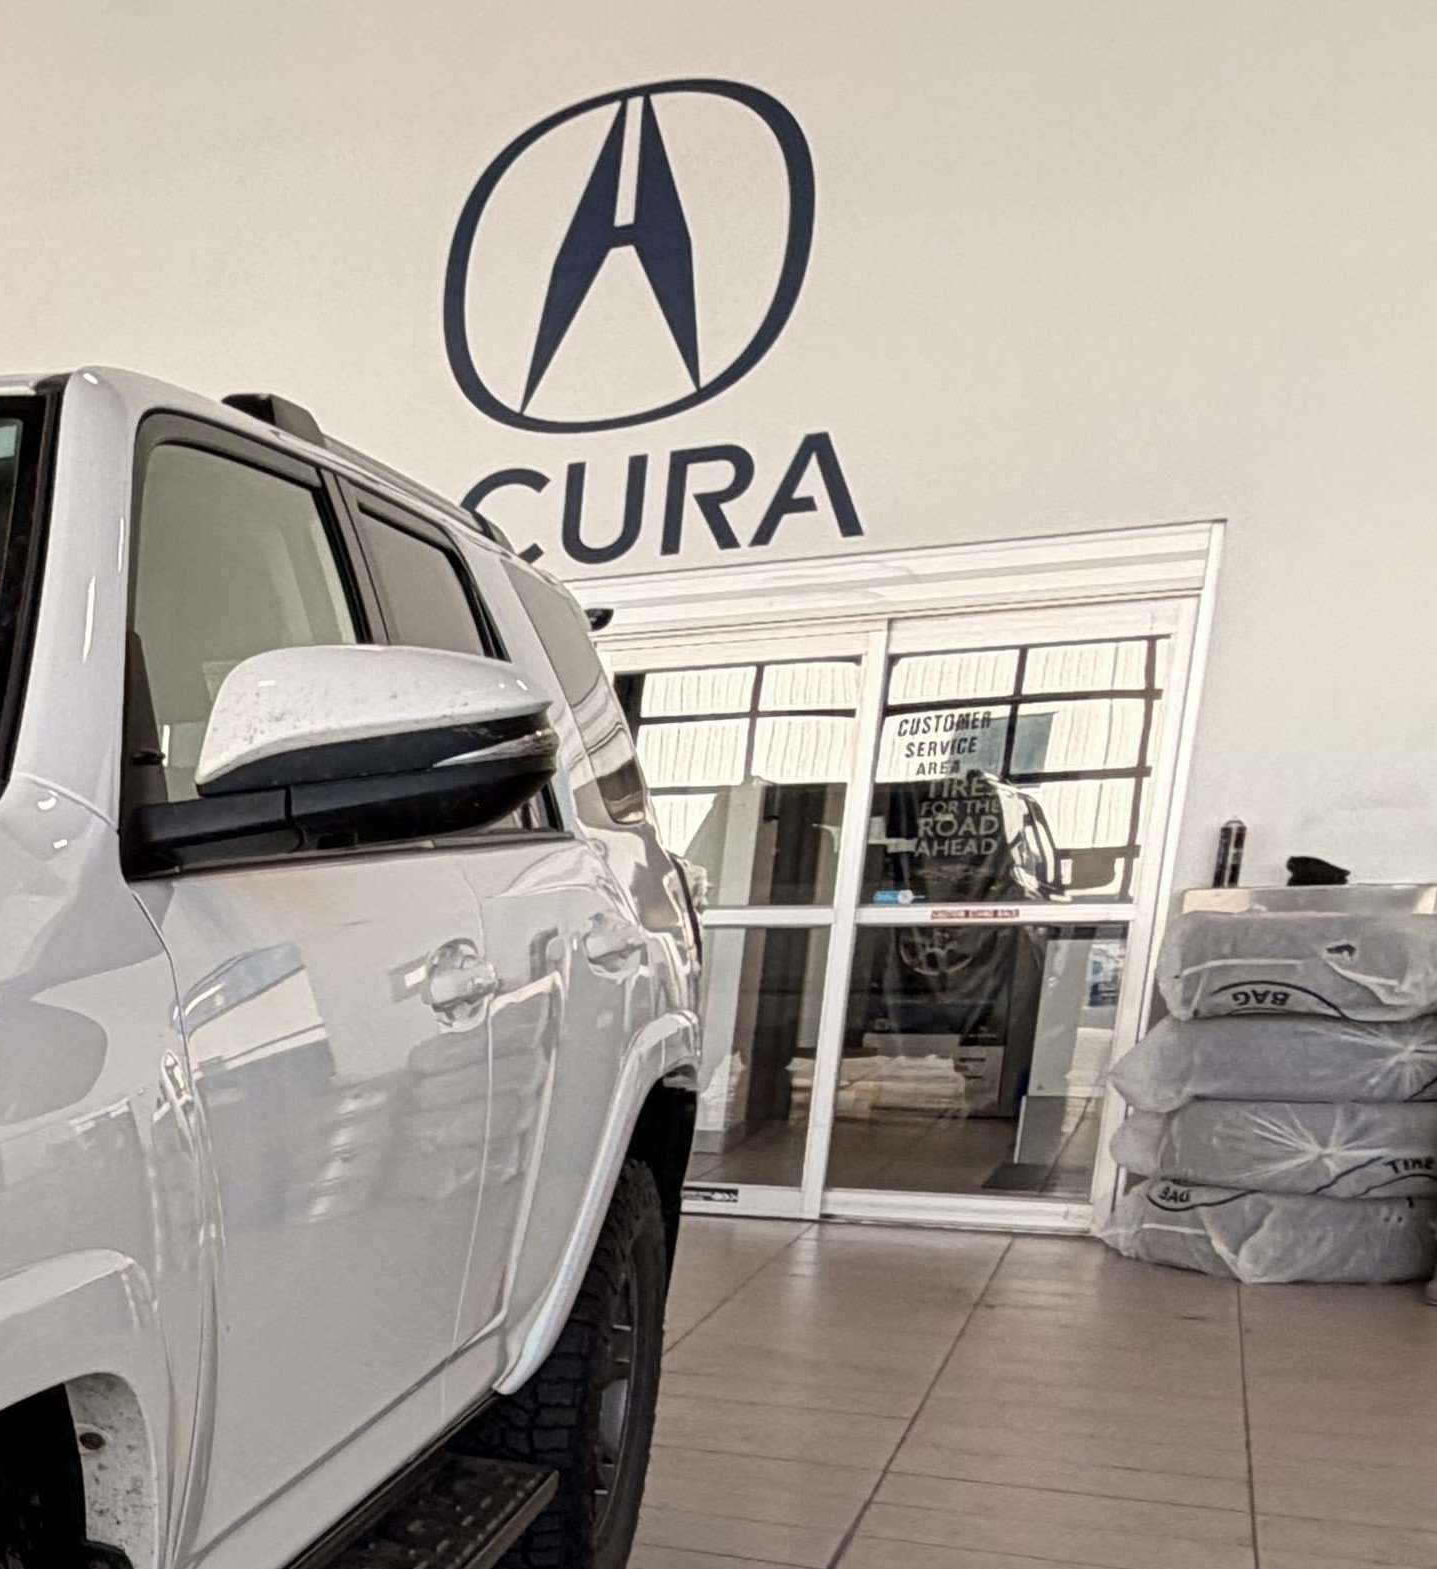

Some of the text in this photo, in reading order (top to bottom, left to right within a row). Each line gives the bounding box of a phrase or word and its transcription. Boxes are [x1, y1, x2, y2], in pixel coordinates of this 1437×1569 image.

[459, 431, 864, 565] CURA
[897, 711, 992, 737] CUSTOMER
[905, 736, 978, 758] SERVICE
[916, 760, 961, 776] AREA
[920, 799, 1001, 816] FOR THE
[917, 814, 1000, 837] ROAD
[914, 837, 999, 857] AHEAD
[1231, 989, 1291, 1006] BAG
